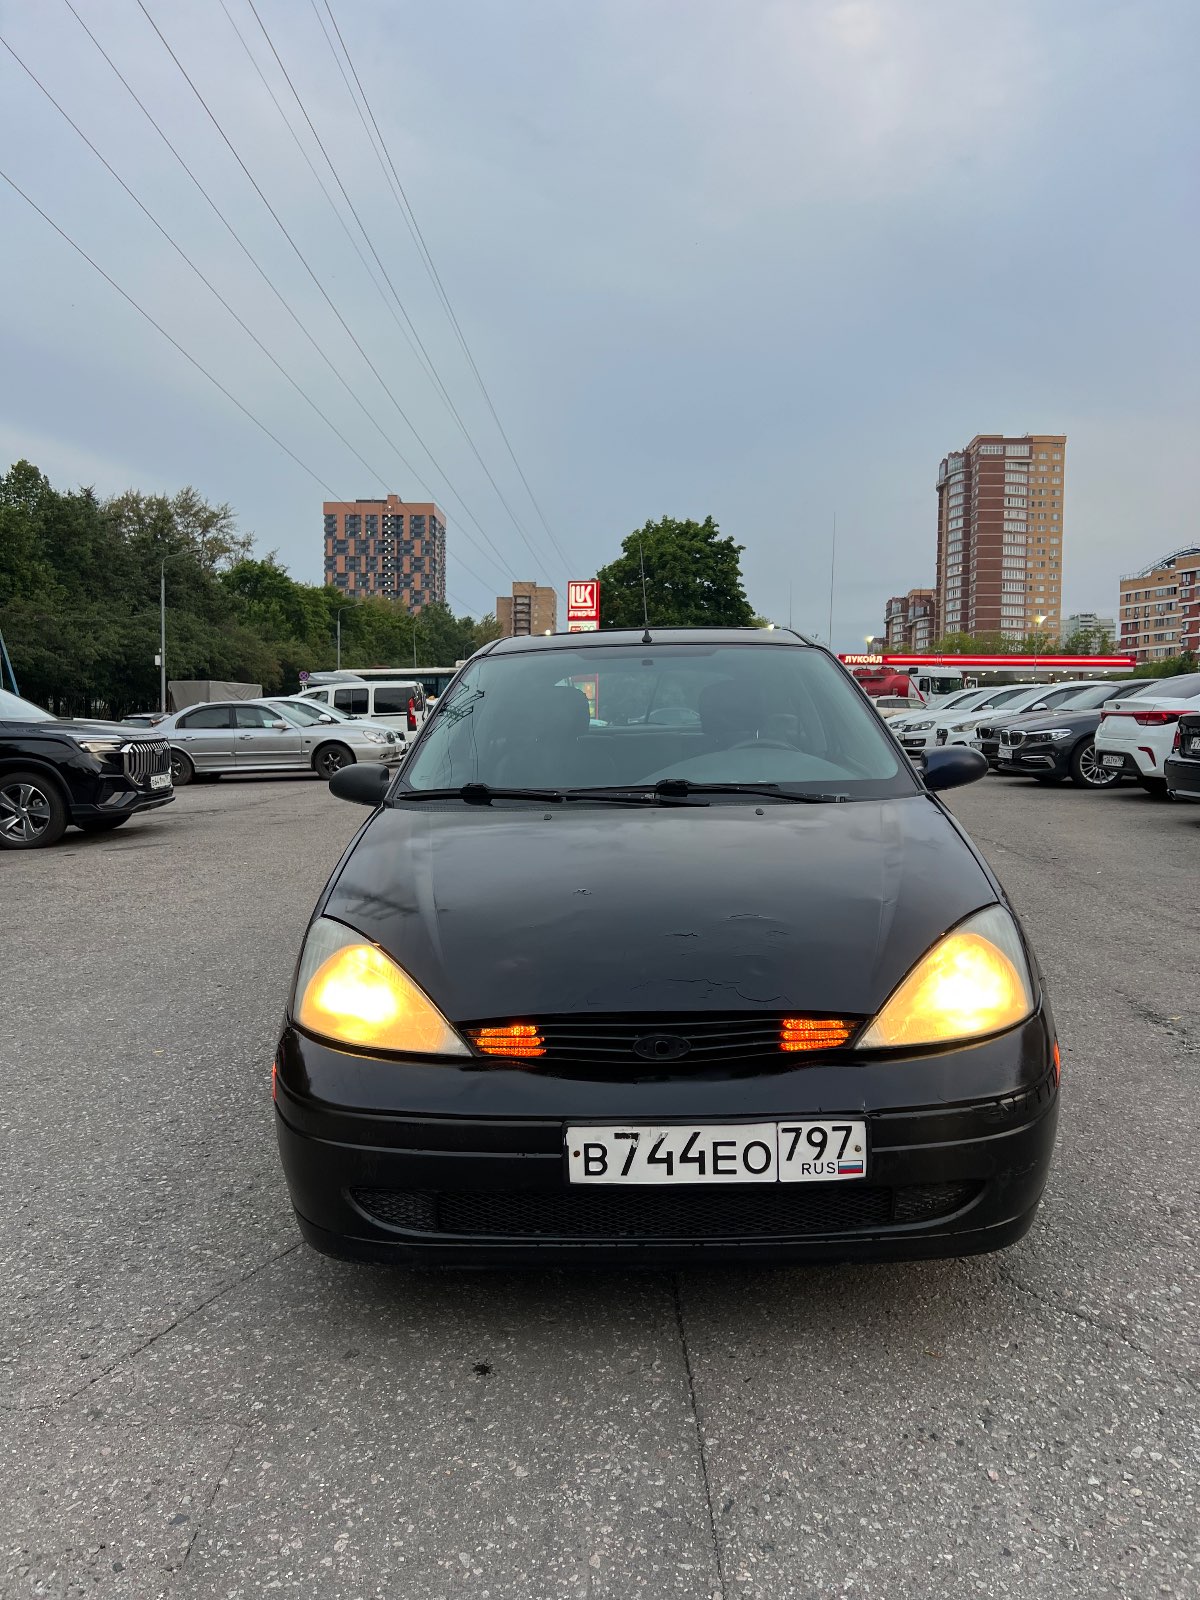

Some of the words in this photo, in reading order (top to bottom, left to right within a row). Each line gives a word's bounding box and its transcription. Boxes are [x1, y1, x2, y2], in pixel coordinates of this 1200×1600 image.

[845, 654, 883, 664] ЛУКОЙЛ
[583, 1131, 772, 1176] В744ЕО
[781, 1125, 853, 1161] 797
[801, 1162, 836, 1175] RUS
